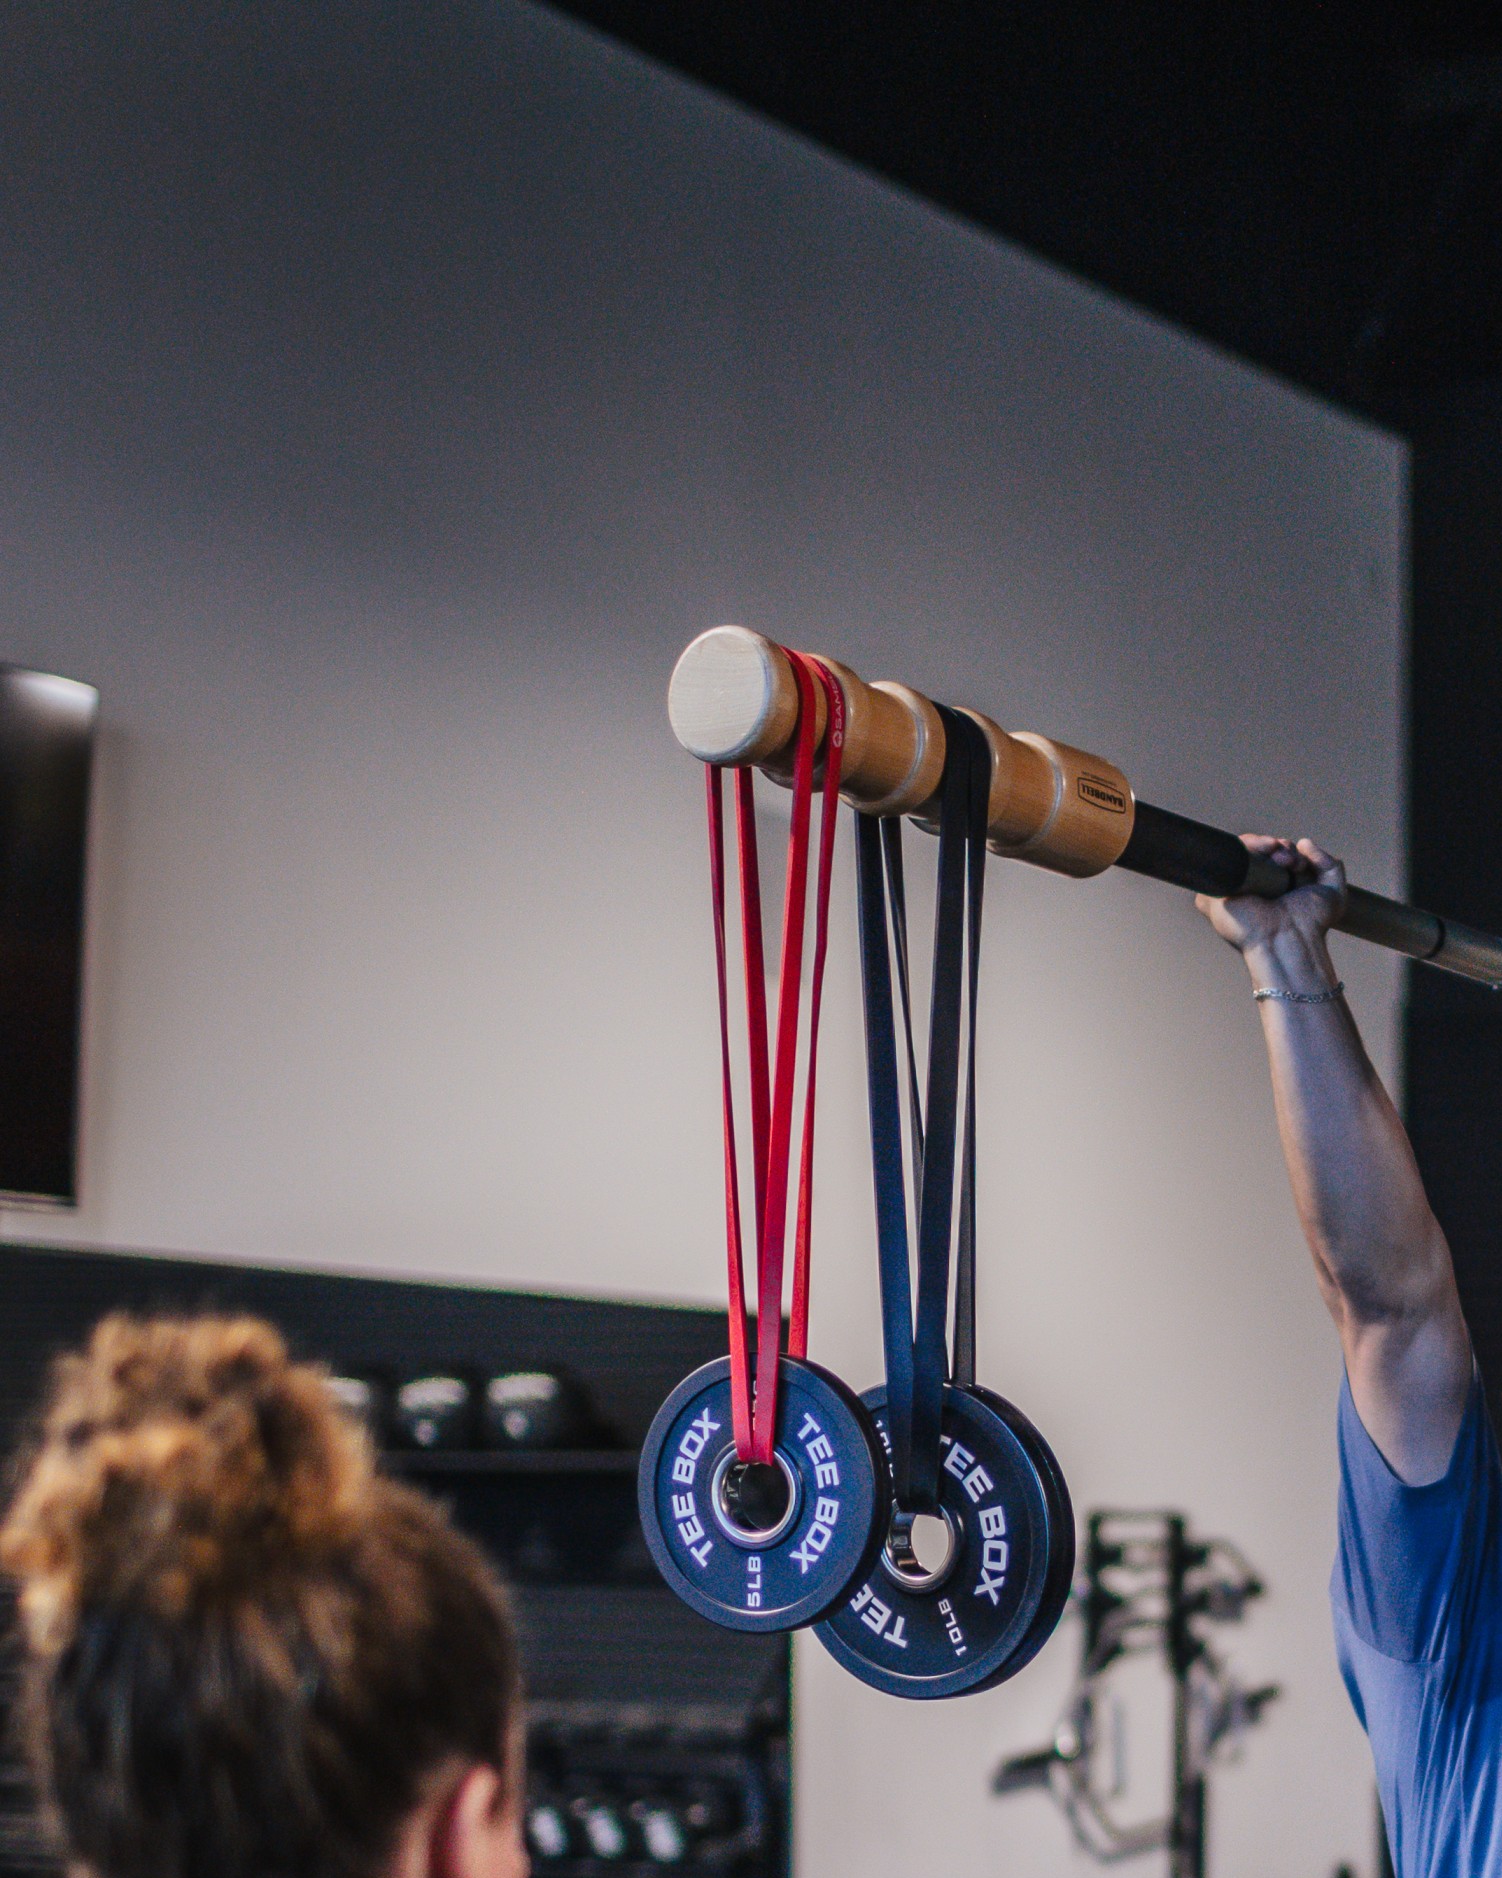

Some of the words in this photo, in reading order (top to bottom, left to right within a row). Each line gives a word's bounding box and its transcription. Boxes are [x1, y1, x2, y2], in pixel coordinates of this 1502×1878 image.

[672, 1407, 721, 1485] BOX
[797, 1412, 840, 1489] TEE
[672, 1492, 713, 1568] TEE
[789, 1496, 840, 1575] BOX
[939, 1434, 994, 1503] EE
[974, 1505, 1009, 1606] BOX
[747, 1555, 761, 1608] 5LB
[938, 1598, 967, 1656] 10LB
